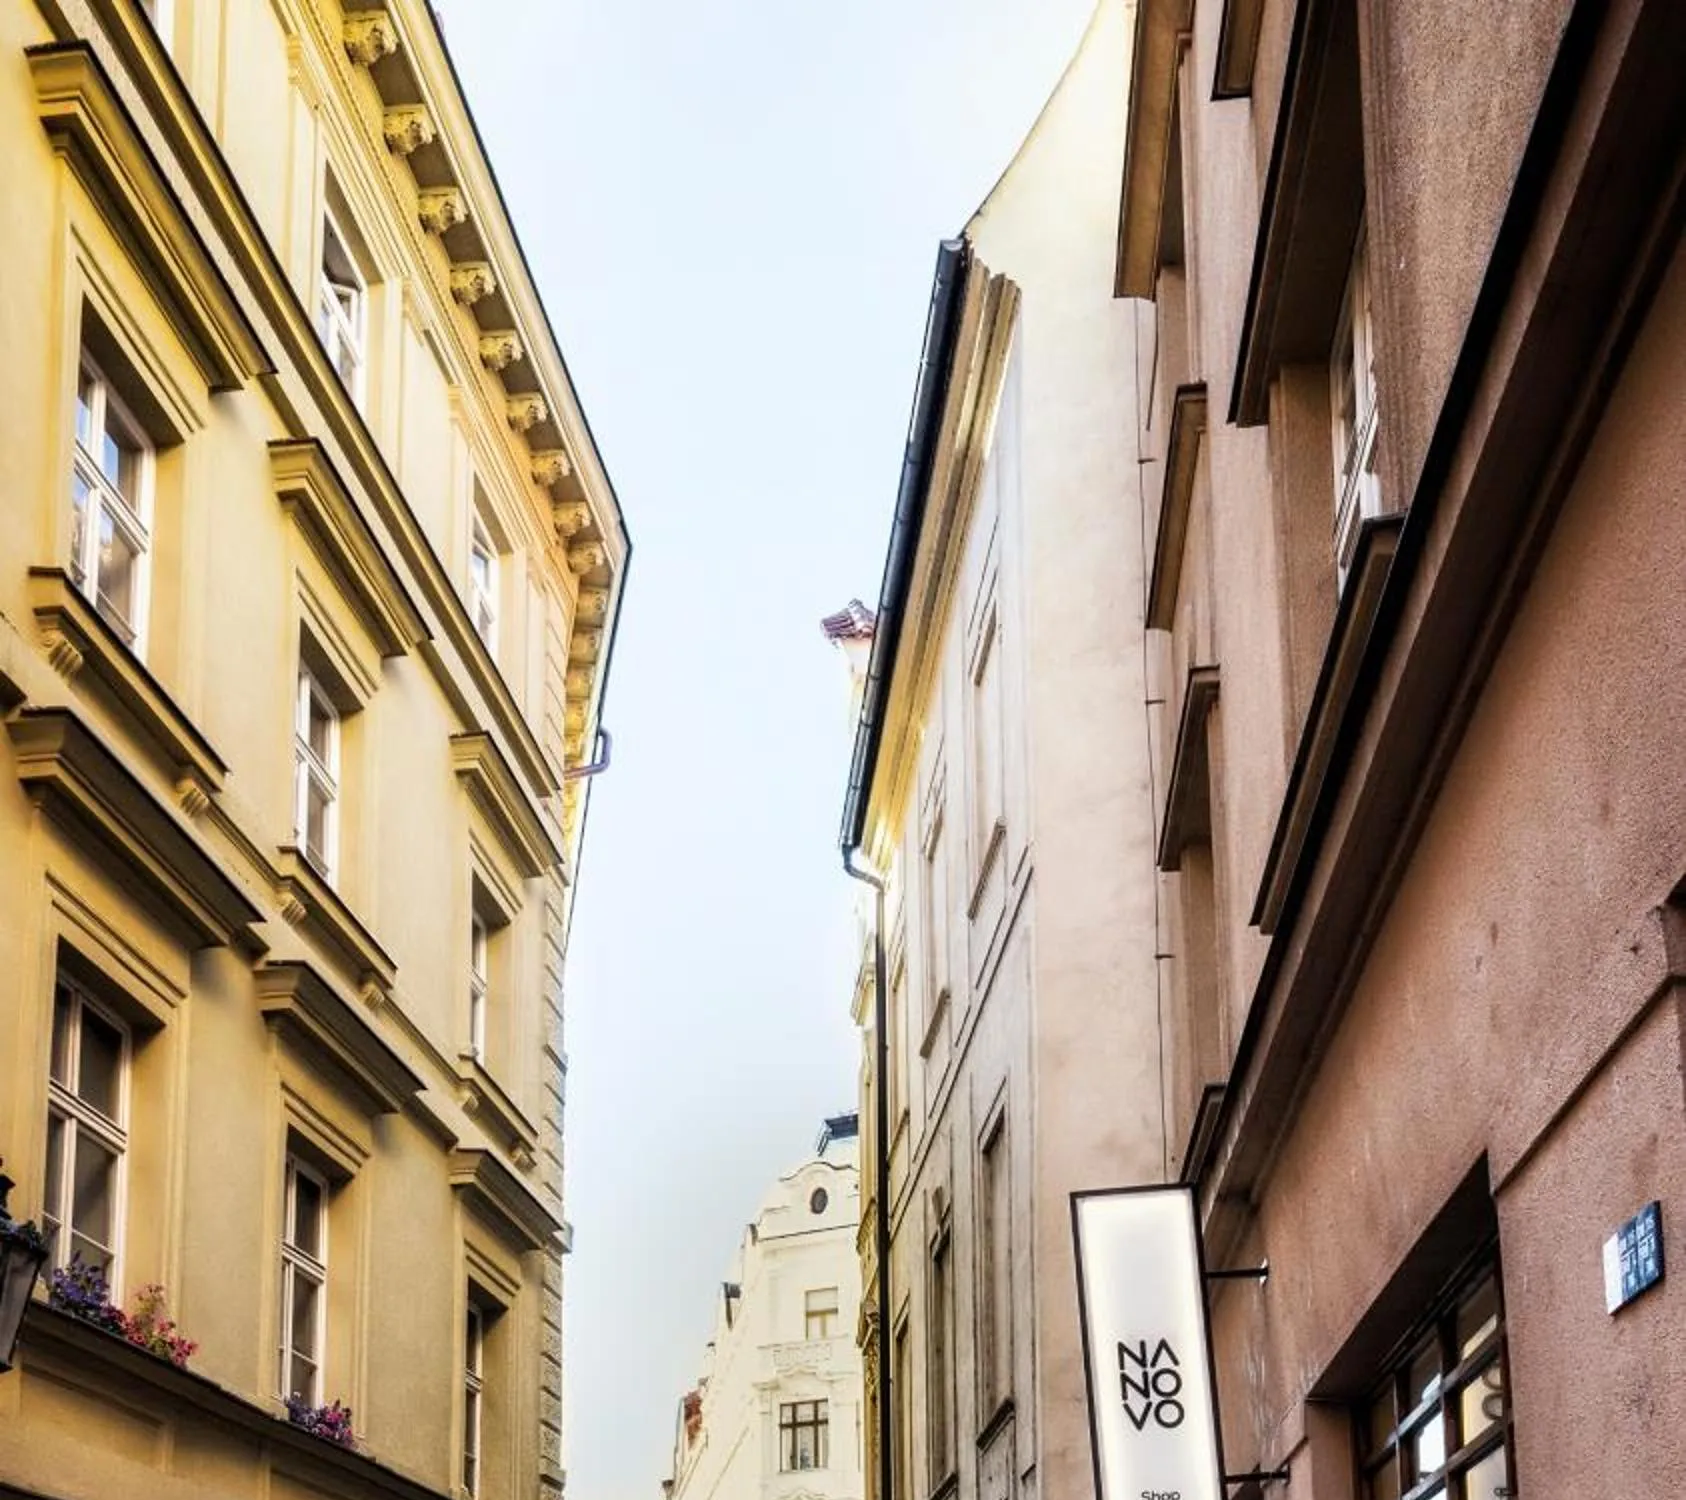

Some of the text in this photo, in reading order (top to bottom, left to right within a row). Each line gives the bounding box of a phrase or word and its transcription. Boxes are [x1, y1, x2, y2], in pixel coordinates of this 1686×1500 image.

[1117, 1337, 1180, 1370] NA
[1120, 1368, 1182, 1400] NO
[1122, 1399, 1185, 1431] VO
